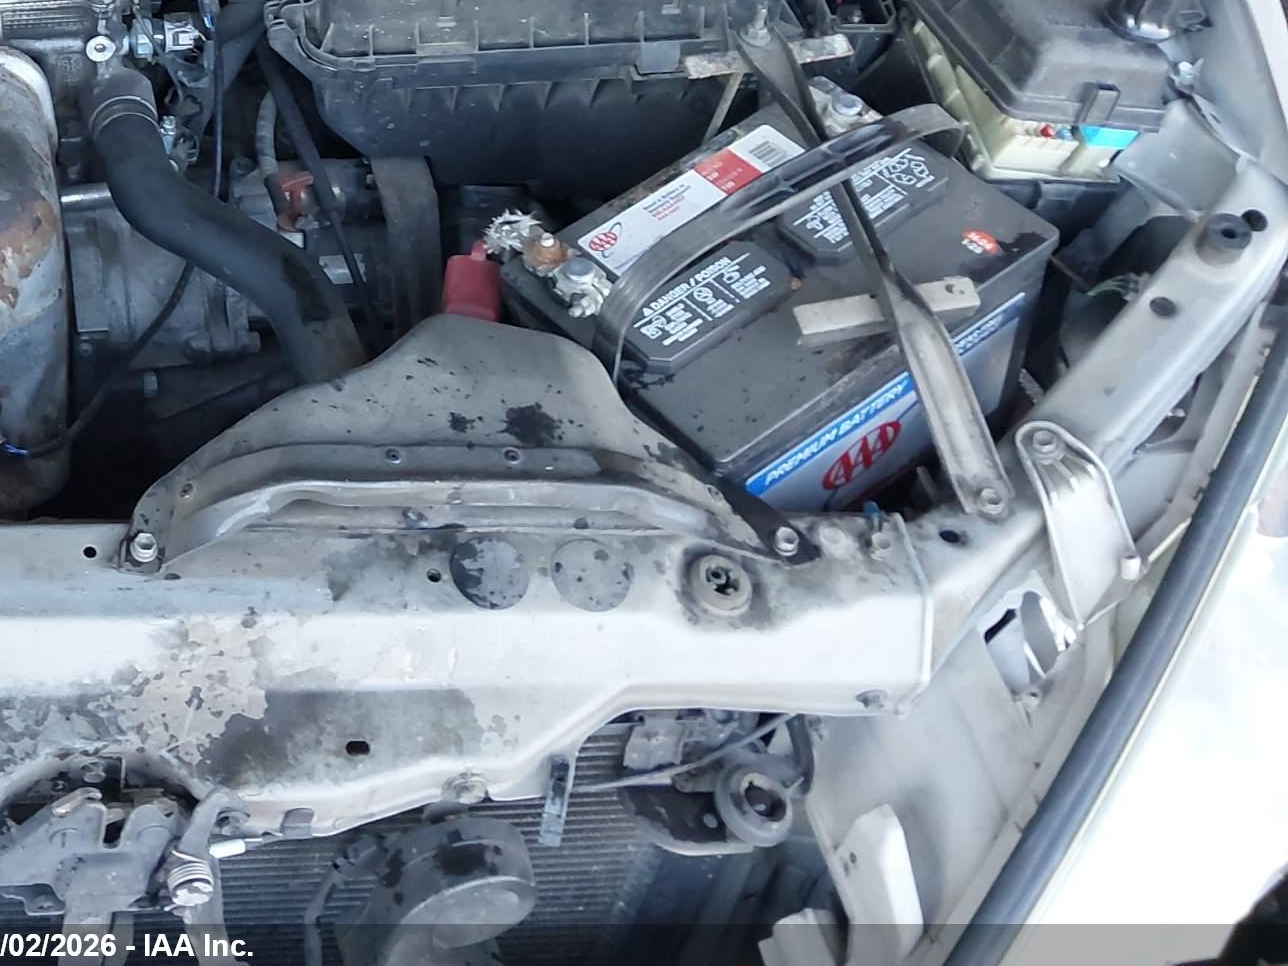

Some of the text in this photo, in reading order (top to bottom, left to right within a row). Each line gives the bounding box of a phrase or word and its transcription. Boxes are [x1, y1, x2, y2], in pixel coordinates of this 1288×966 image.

[650, 282, 691, 311] DANGER
[694, 256, 732, 283] POISON
[765, 380, 908, 486] PREMIUM BATTERY
[821, 420, 902, 491] AAA
